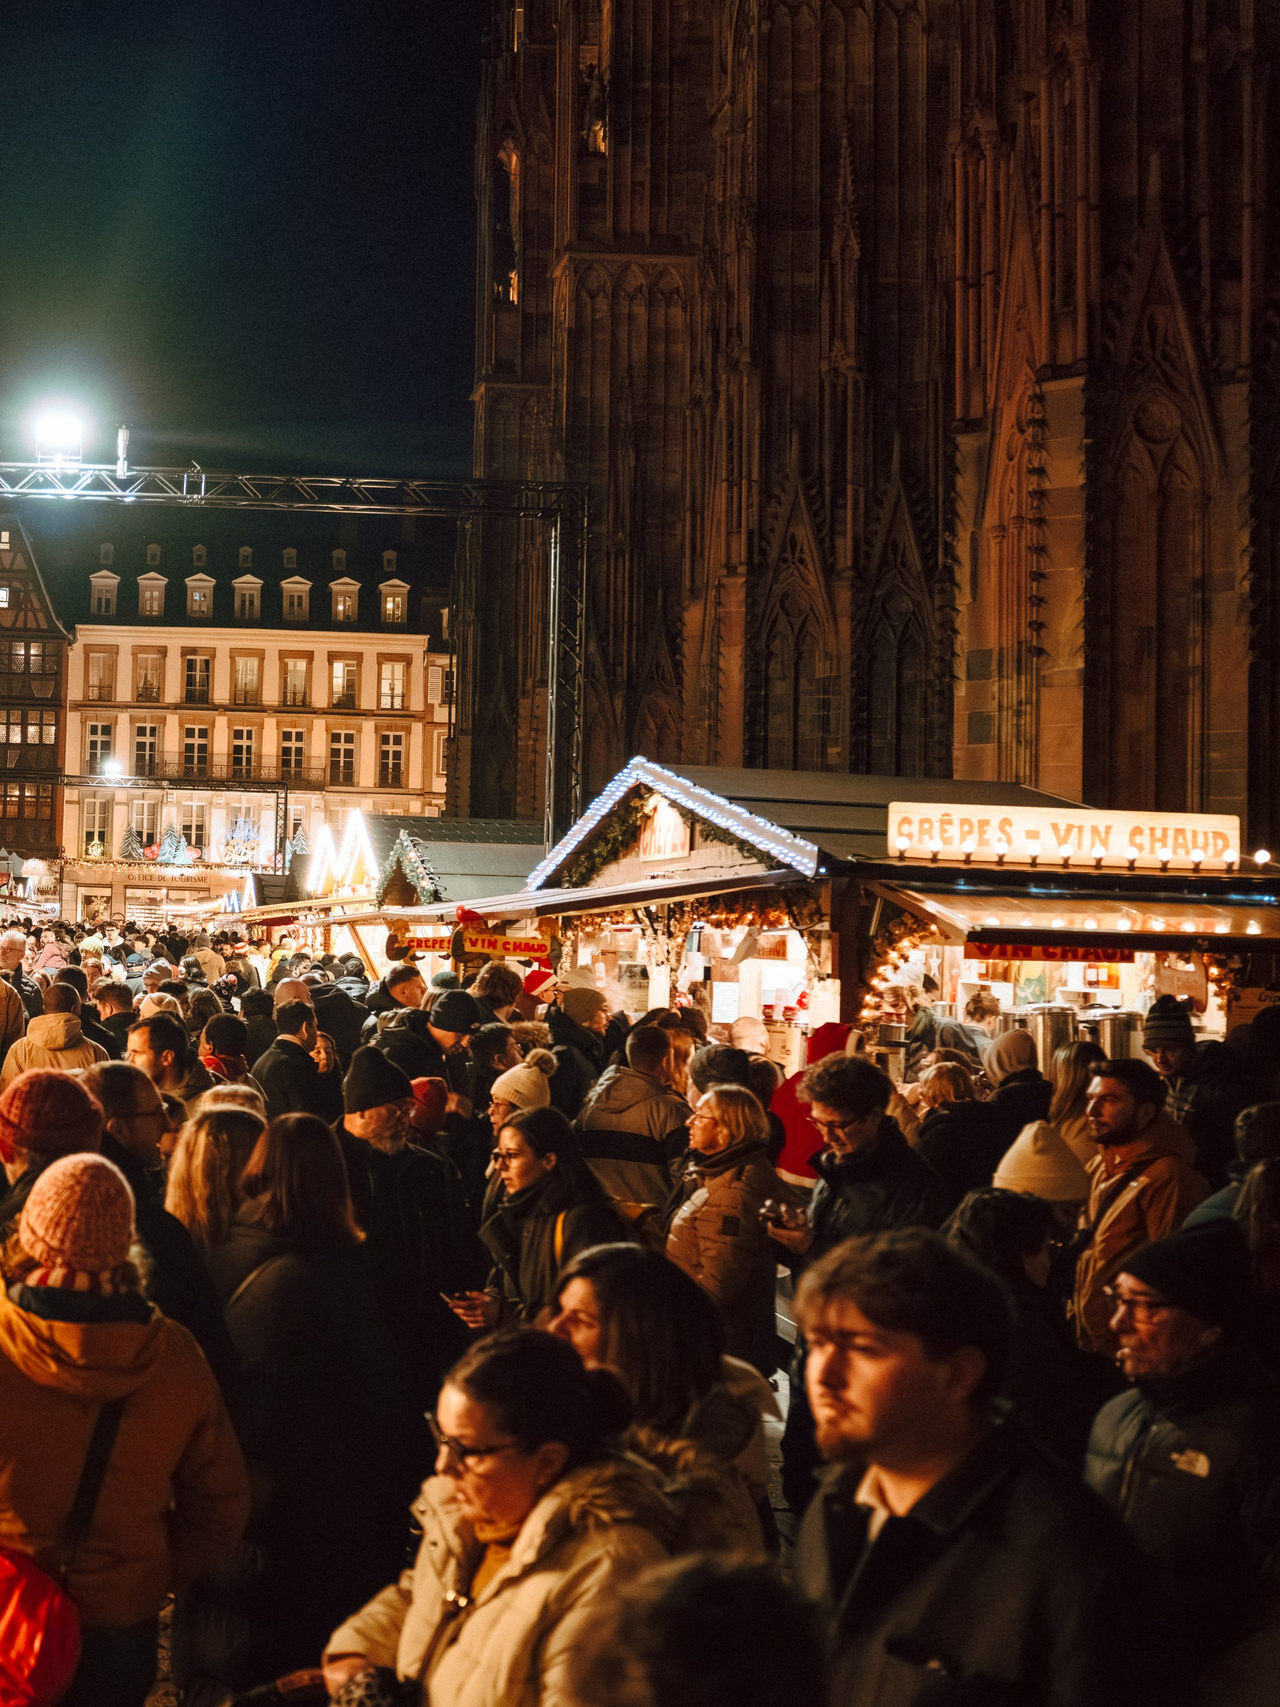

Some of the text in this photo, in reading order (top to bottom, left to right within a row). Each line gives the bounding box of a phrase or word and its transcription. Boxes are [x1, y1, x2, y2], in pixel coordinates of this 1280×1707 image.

[897, 812, 1013, 847] CRÊPES
[1051, 822, 1113, 852] VIN
[1128, 825, 1230, 858] CHAUD
[127, 873, 209, 884] OFFICE DE TOURISME
[469, 937, 499, 951] VIN
[501, 940, 548, 954] CHAUD
[973, 942, 1033, 957] VIN
